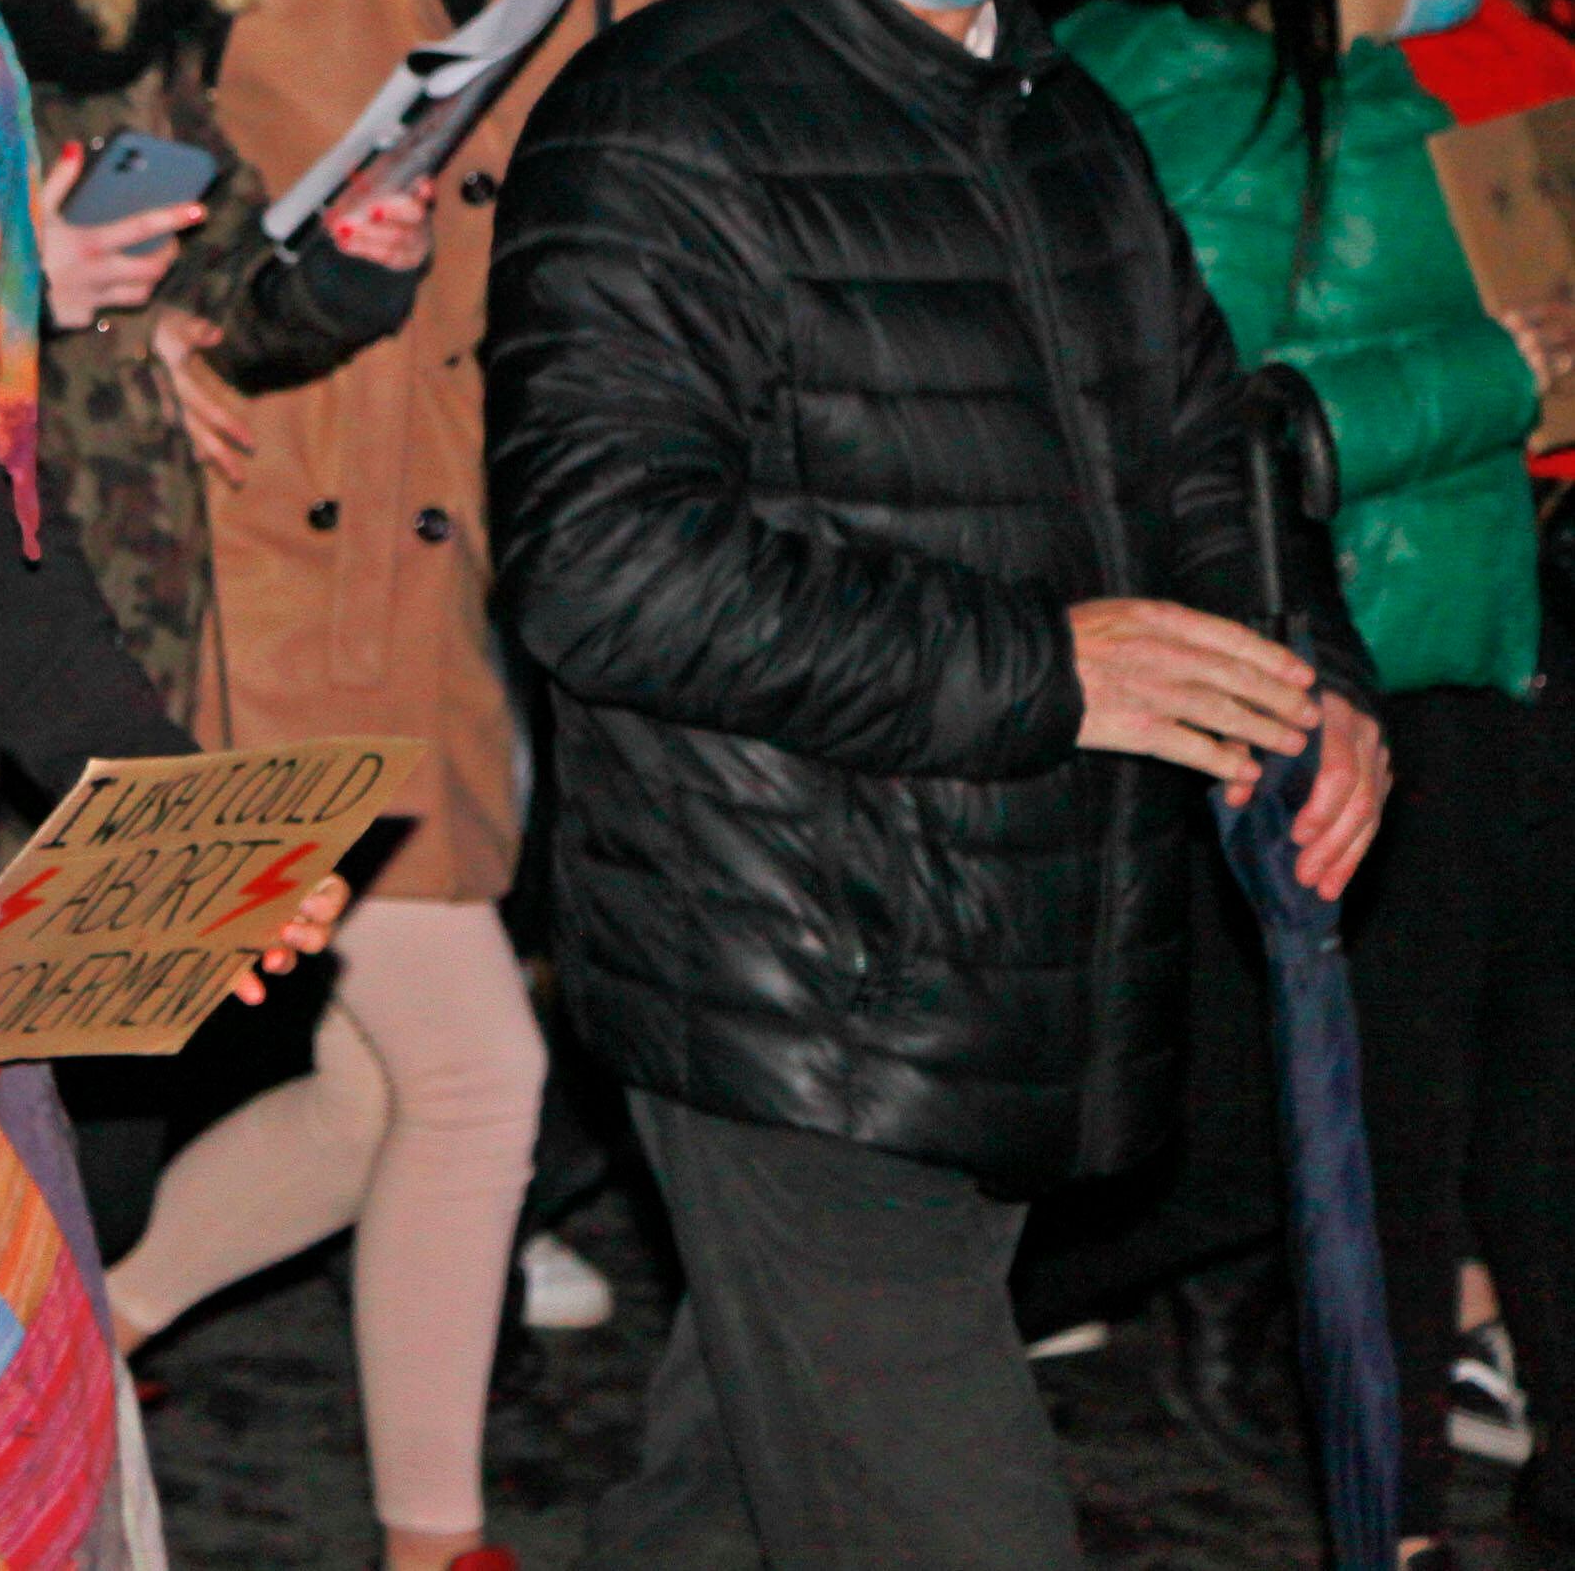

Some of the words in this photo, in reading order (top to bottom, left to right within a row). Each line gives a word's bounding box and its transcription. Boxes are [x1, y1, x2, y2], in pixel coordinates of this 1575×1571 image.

[38, 776, 118, 850] I
[86, 764, 219, 846] WISH
[225, 752, 384, 826] COULD
[28, 839, 283, 941] ABORT
